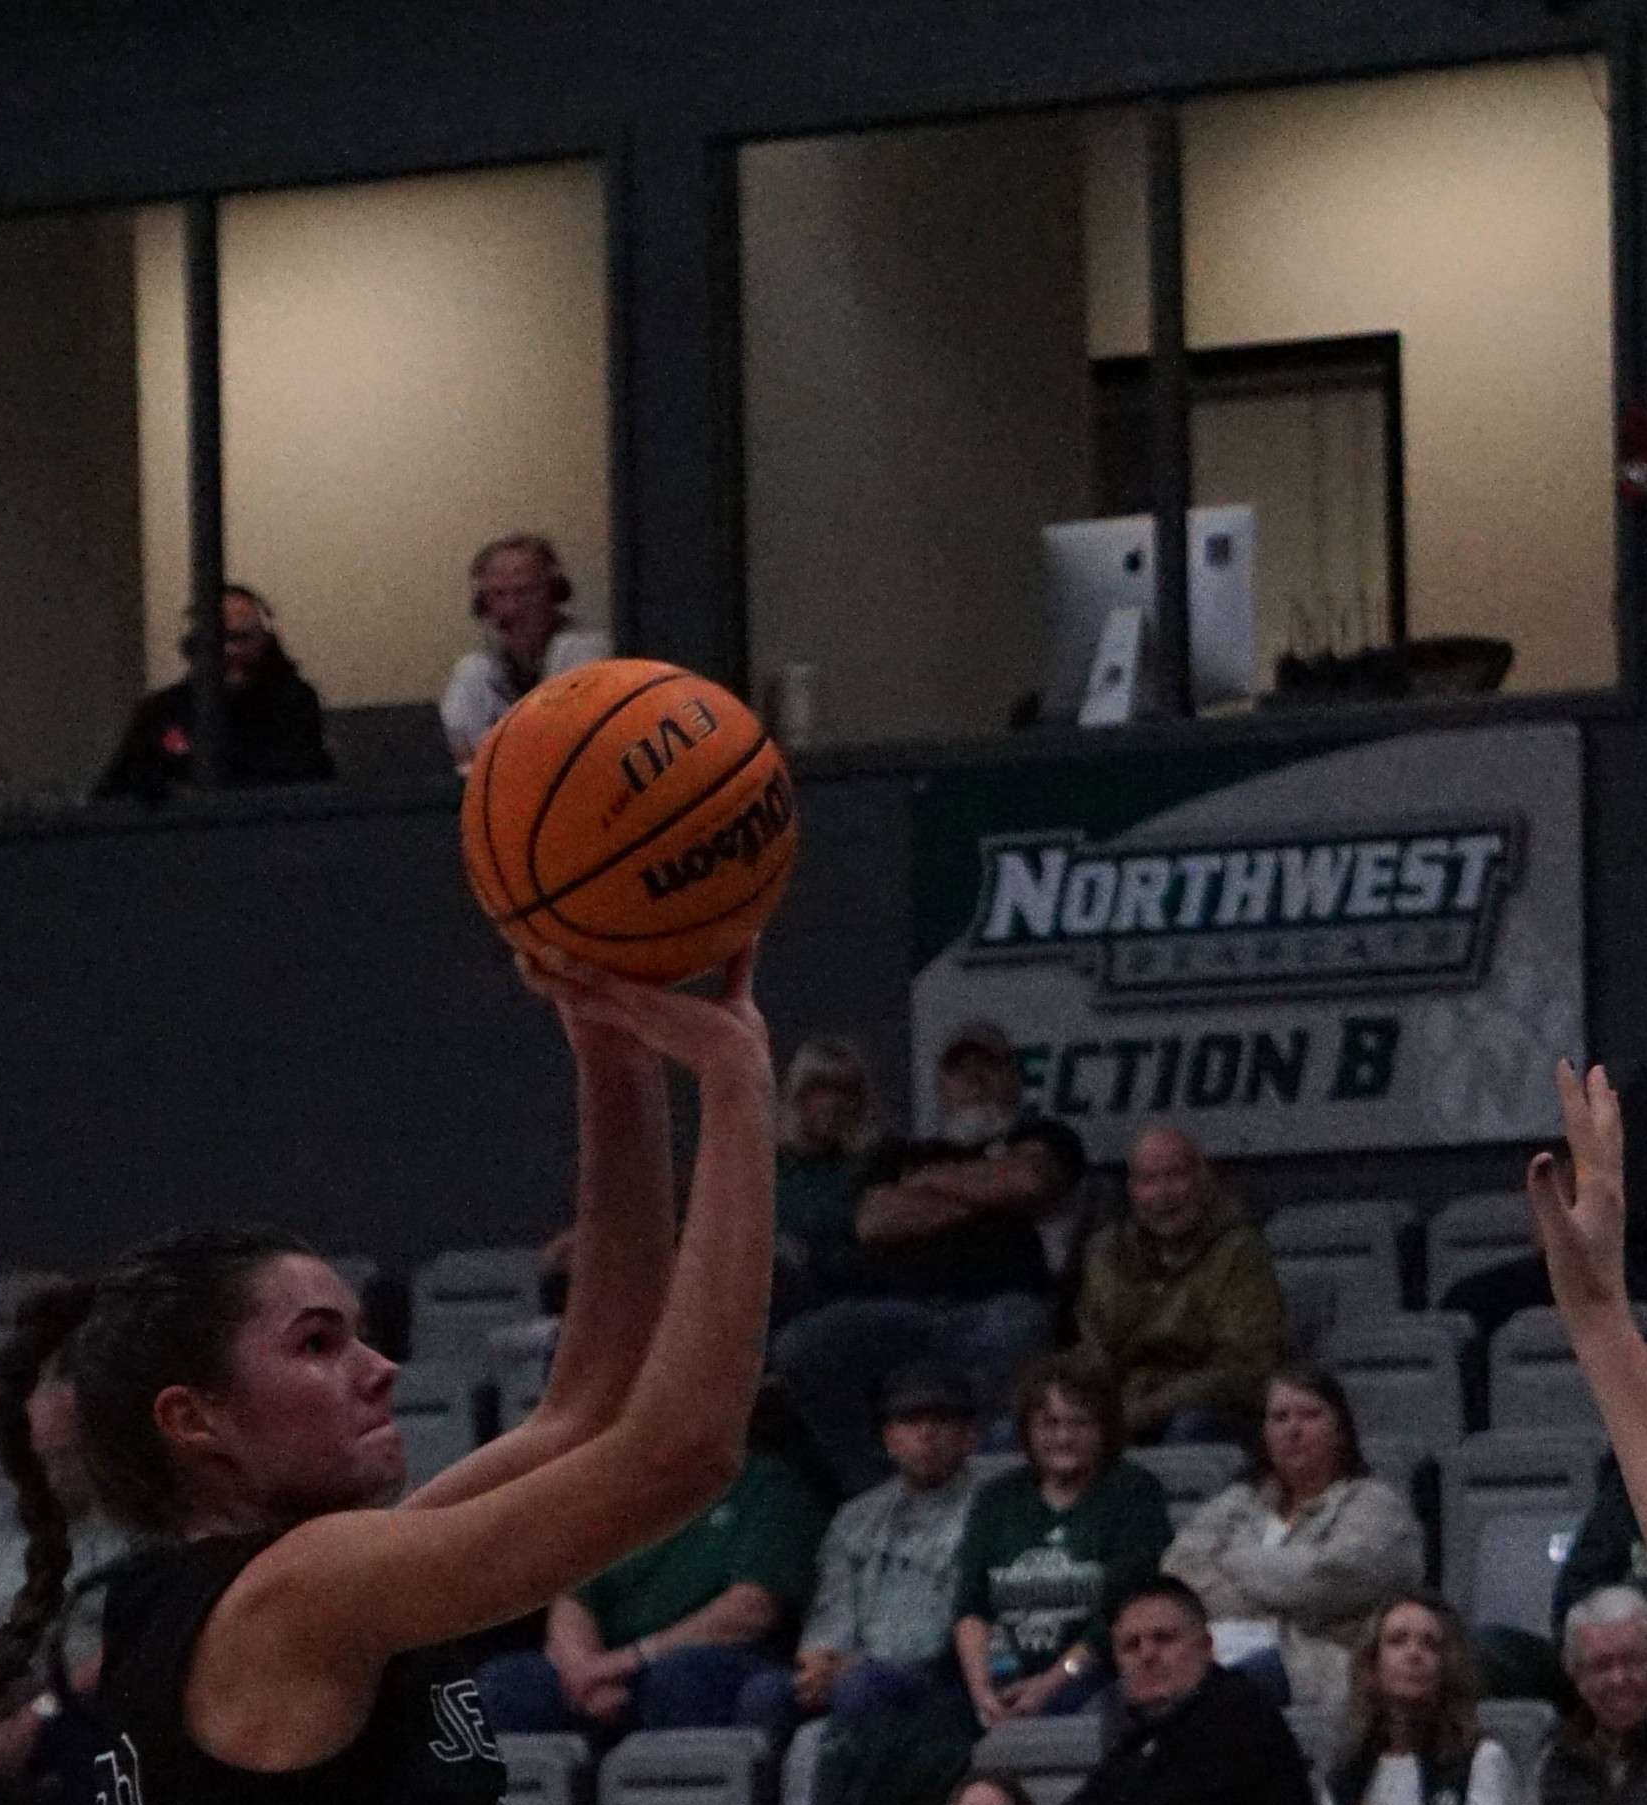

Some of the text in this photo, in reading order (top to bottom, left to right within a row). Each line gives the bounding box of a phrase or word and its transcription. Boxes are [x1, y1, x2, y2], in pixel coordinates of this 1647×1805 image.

[982, 833, 1504, 943] NORTHWEST
[1014, 1017, 1401, 1118] ECTION B
